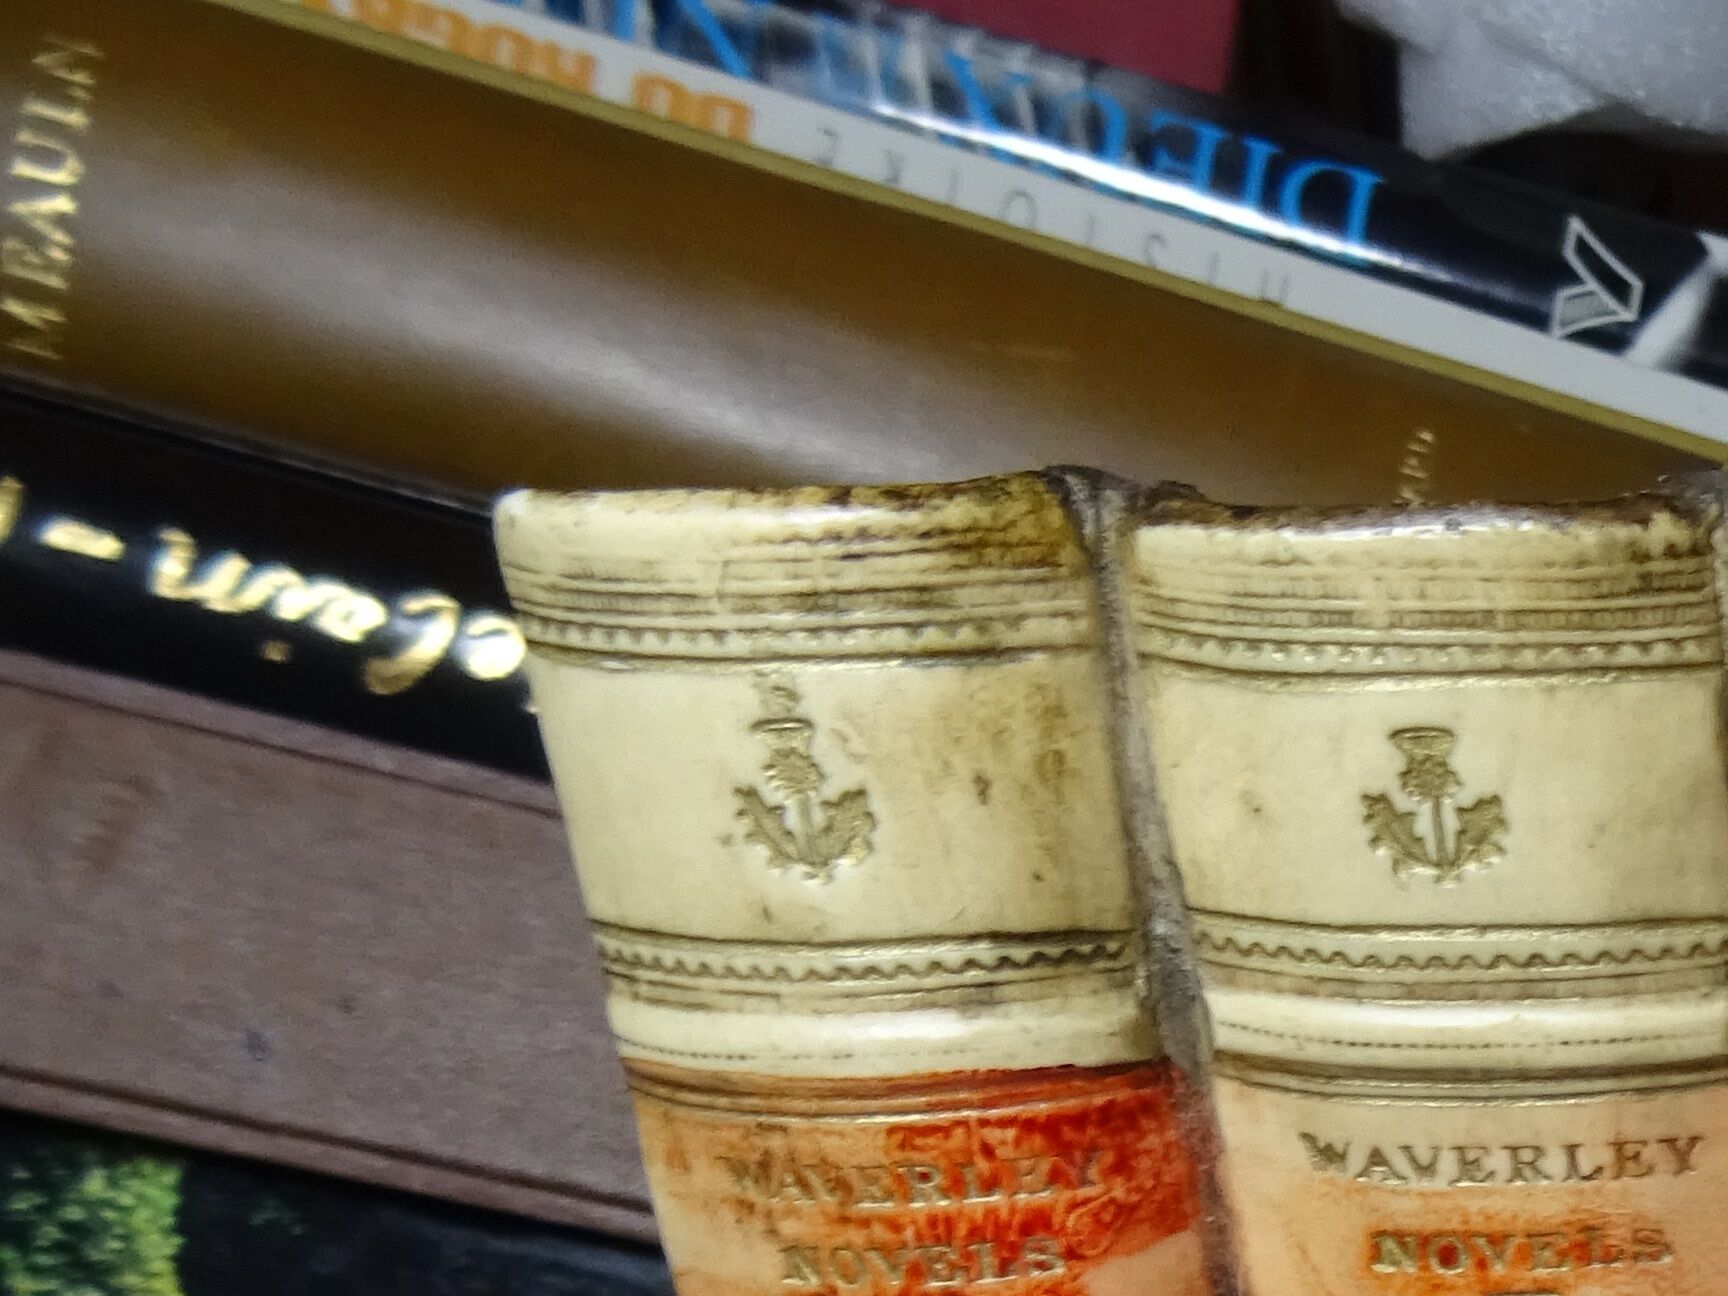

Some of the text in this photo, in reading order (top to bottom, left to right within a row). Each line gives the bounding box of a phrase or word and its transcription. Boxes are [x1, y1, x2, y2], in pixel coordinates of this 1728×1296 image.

[717, 1148, 1106, 1209] WAVERLEY
[1299, 1131, 1705, 1187] WAVERLEY
[780, 1236, 1068, 1286] NOVELS
[1370, 1226, 1674, 1274] NOVELS
